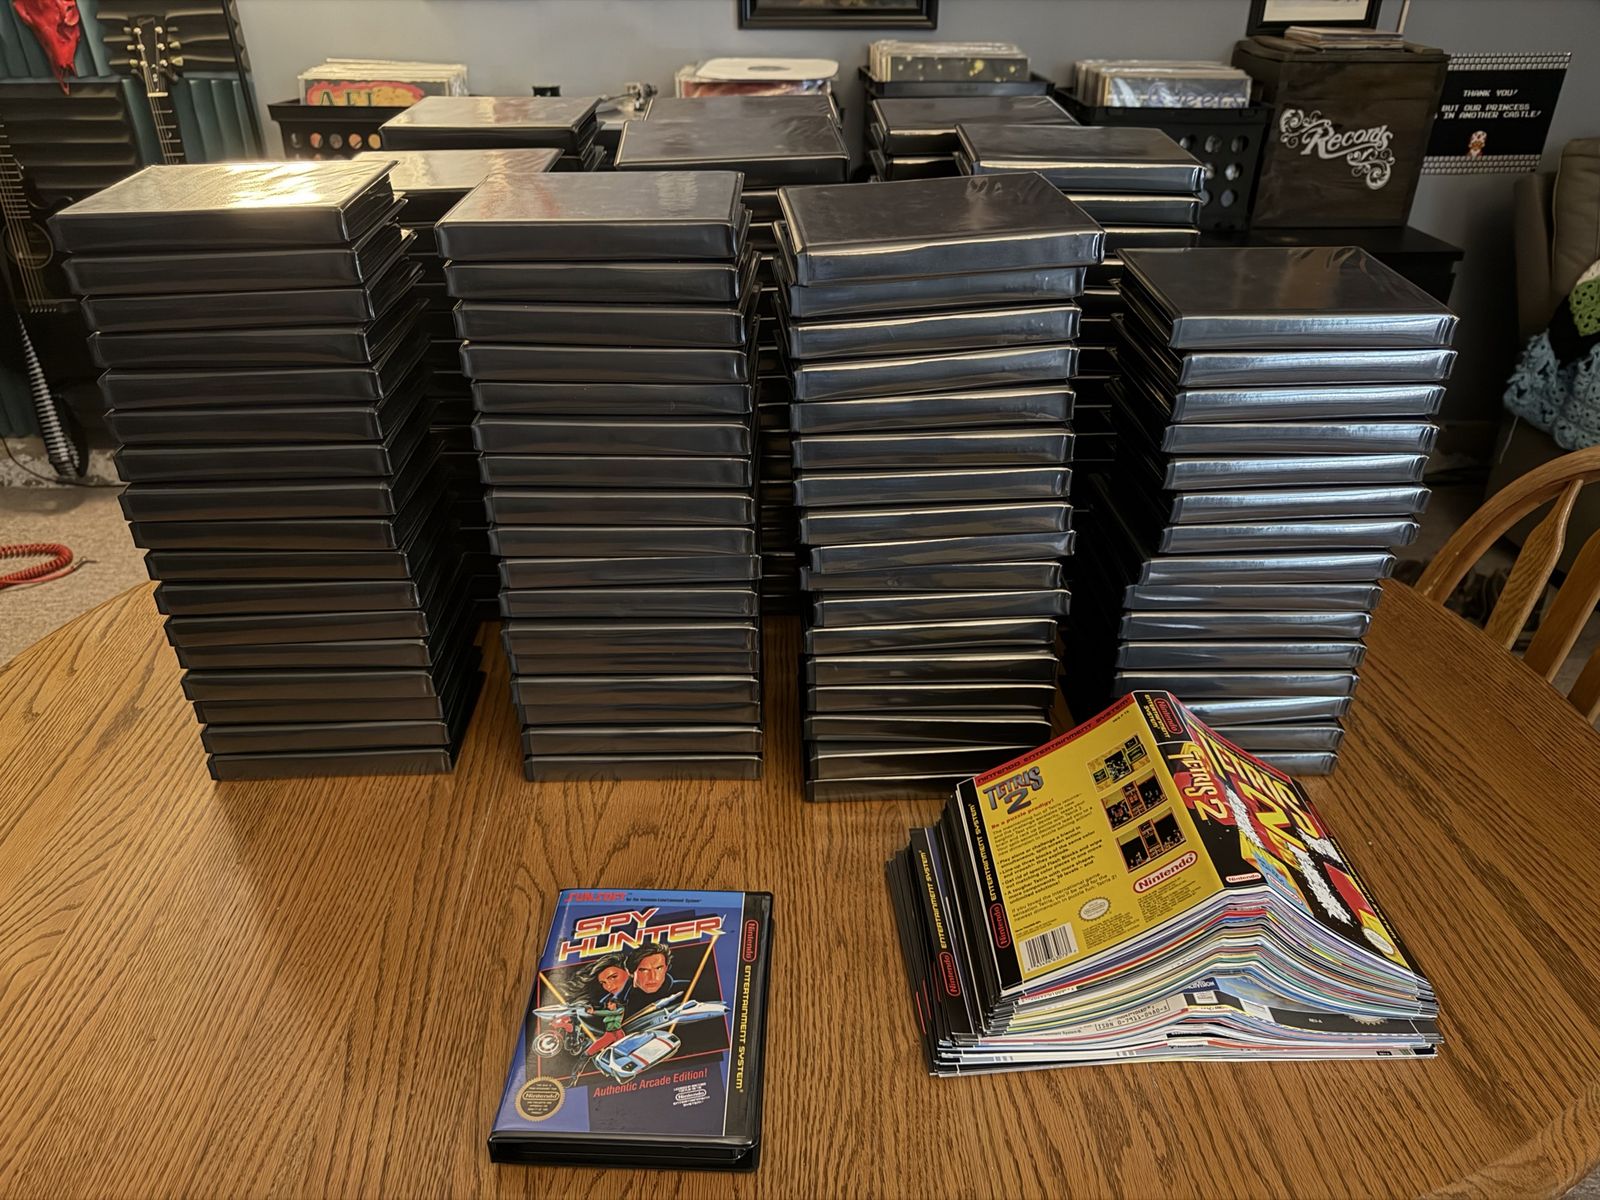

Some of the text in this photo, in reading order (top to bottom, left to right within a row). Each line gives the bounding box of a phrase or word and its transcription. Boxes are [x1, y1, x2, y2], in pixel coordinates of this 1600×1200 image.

[1441, 103, 1530, 112] BUT OUR PRINCESS
[1463, 88, 1519, 97] THANK YOU!
[1443, 112, 1455, 120] IN
[1458, 111, 1499, 119] ANOTHER
[1503, 110, 1542, 118] CASTLE!
[1300, 119, 1393, 159] Records
[1157, 701, 1178, 732] Nintendo
[1023, 724, 1092, 762] ENTERTAINMENT
[983, 766, 1044, 810] TETRIS
[1004, 788, 1032, 815] 2
[977, 836, 997, 902] ENTERTAINMENT
[1137, 855, 1194, 890] Nintendo
[574, 907, 660, 939] SPY
[926, 880, 948, 949] ENTERTAINMENT
[993, 905, 1008, 945] Nintendo
[558, 913, 727, 962] HUNTER
[745, 922, 756, 959] Nintendo
[944, 955, 959, 993] Nintendo
[740, 965, 752, 1044] ENTERTAINMENT
[593, 1081, 637, 1098] Authentic
[639, 1076, 671, 1092] Arcade
[673, 1068, 708, 1085] Edition!
